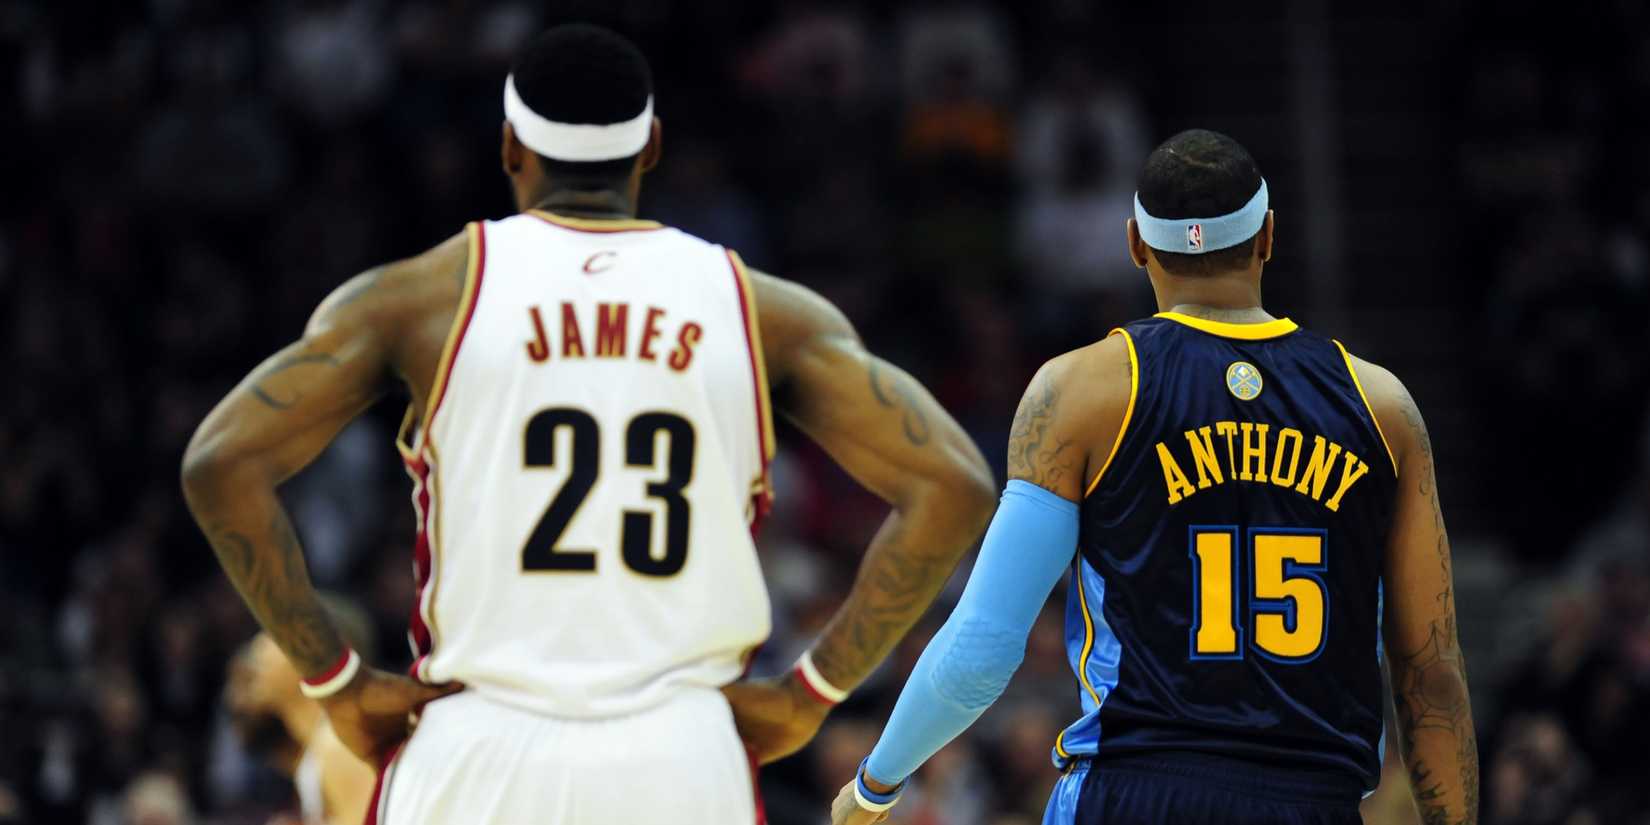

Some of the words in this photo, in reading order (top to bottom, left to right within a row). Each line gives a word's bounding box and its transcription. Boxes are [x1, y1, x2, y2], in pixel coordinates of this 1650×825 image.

[525, 301, 704, 373] JAMES
[520, 406, 697, 579] 23
[1156, 421, 1369, 512] ANTHONY
[1189, 525, 1330, 664] 15
